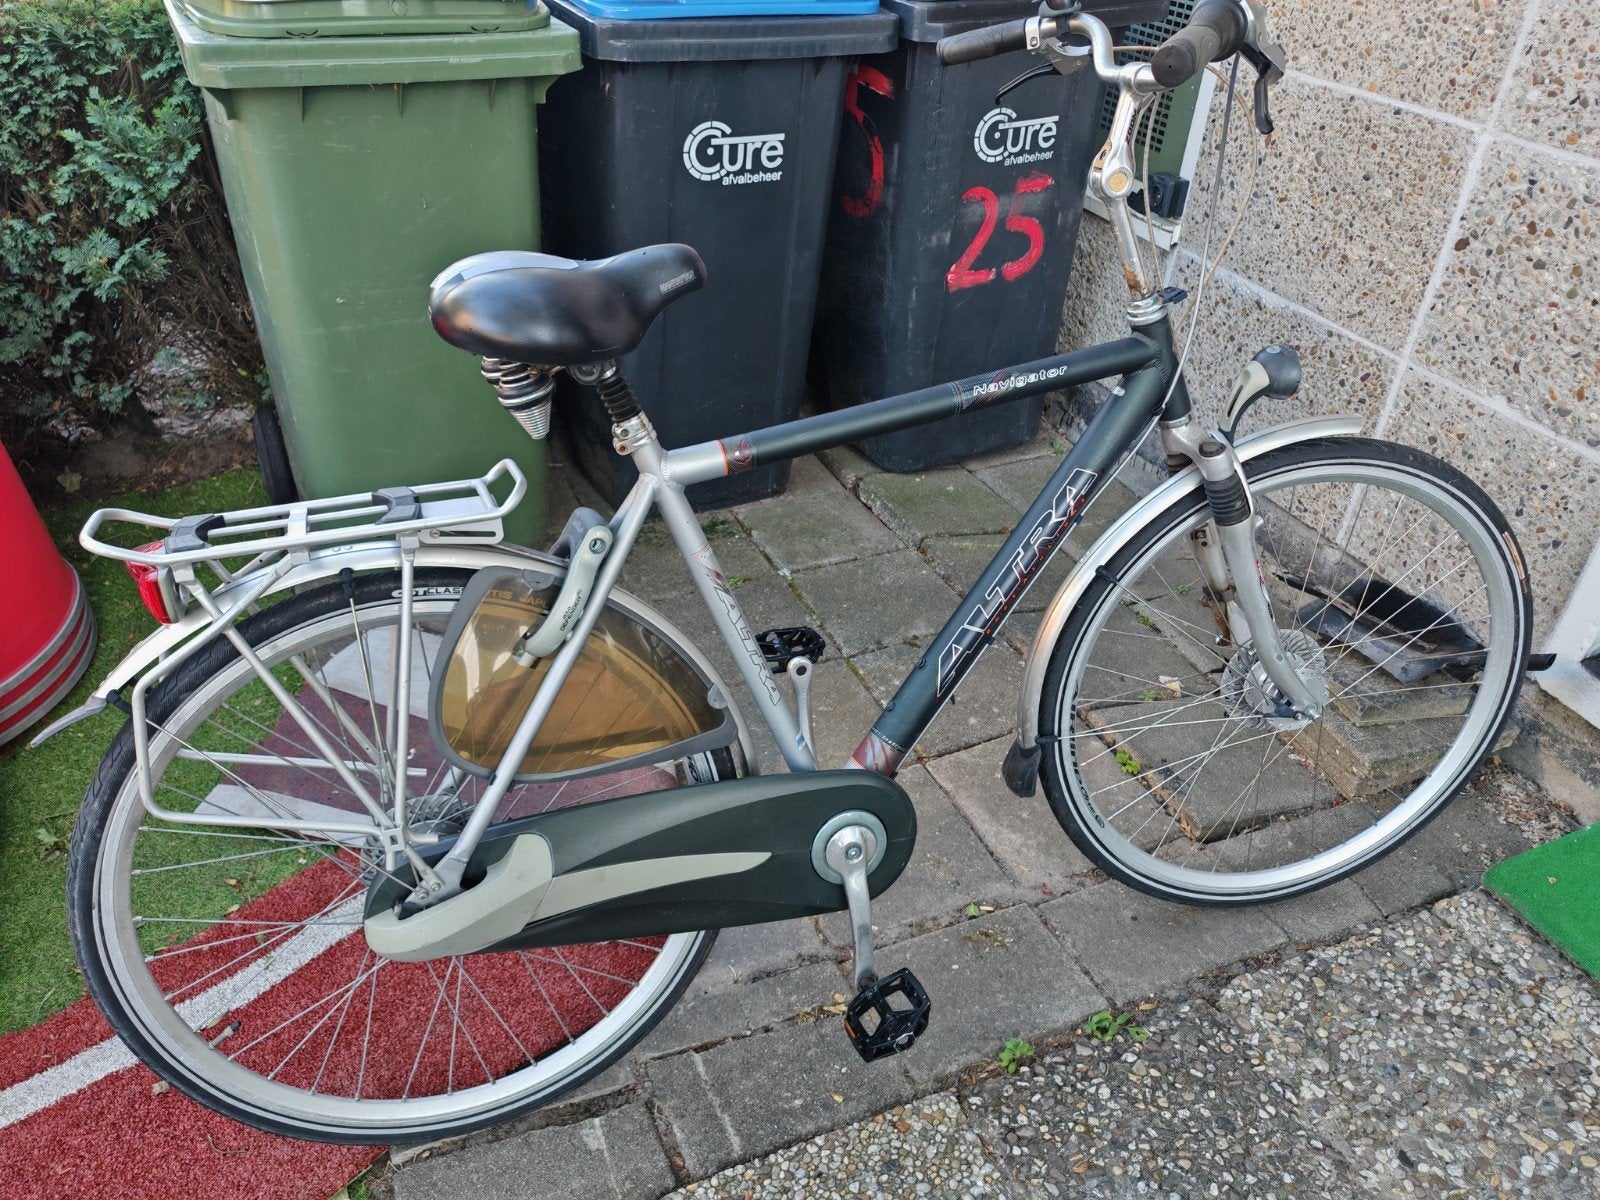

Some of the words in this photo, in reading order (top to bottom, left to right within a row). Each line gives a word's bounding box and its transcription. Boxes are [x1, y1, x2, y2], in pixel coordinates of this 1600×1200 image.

[682, 120, 785, 181] Cure
[973, 107, 1060, 163] Cure
[1003, 150, 1055, 167] afvalbeheer
[722, 170, 783, 185] afvalbeheer
[945, 170, 1055, 293] 25
[972, 365, 1068, 396] Navigator
[936, 467, 1098, 698] ALTRA
[713, 585, 782, 707] ALTRA
